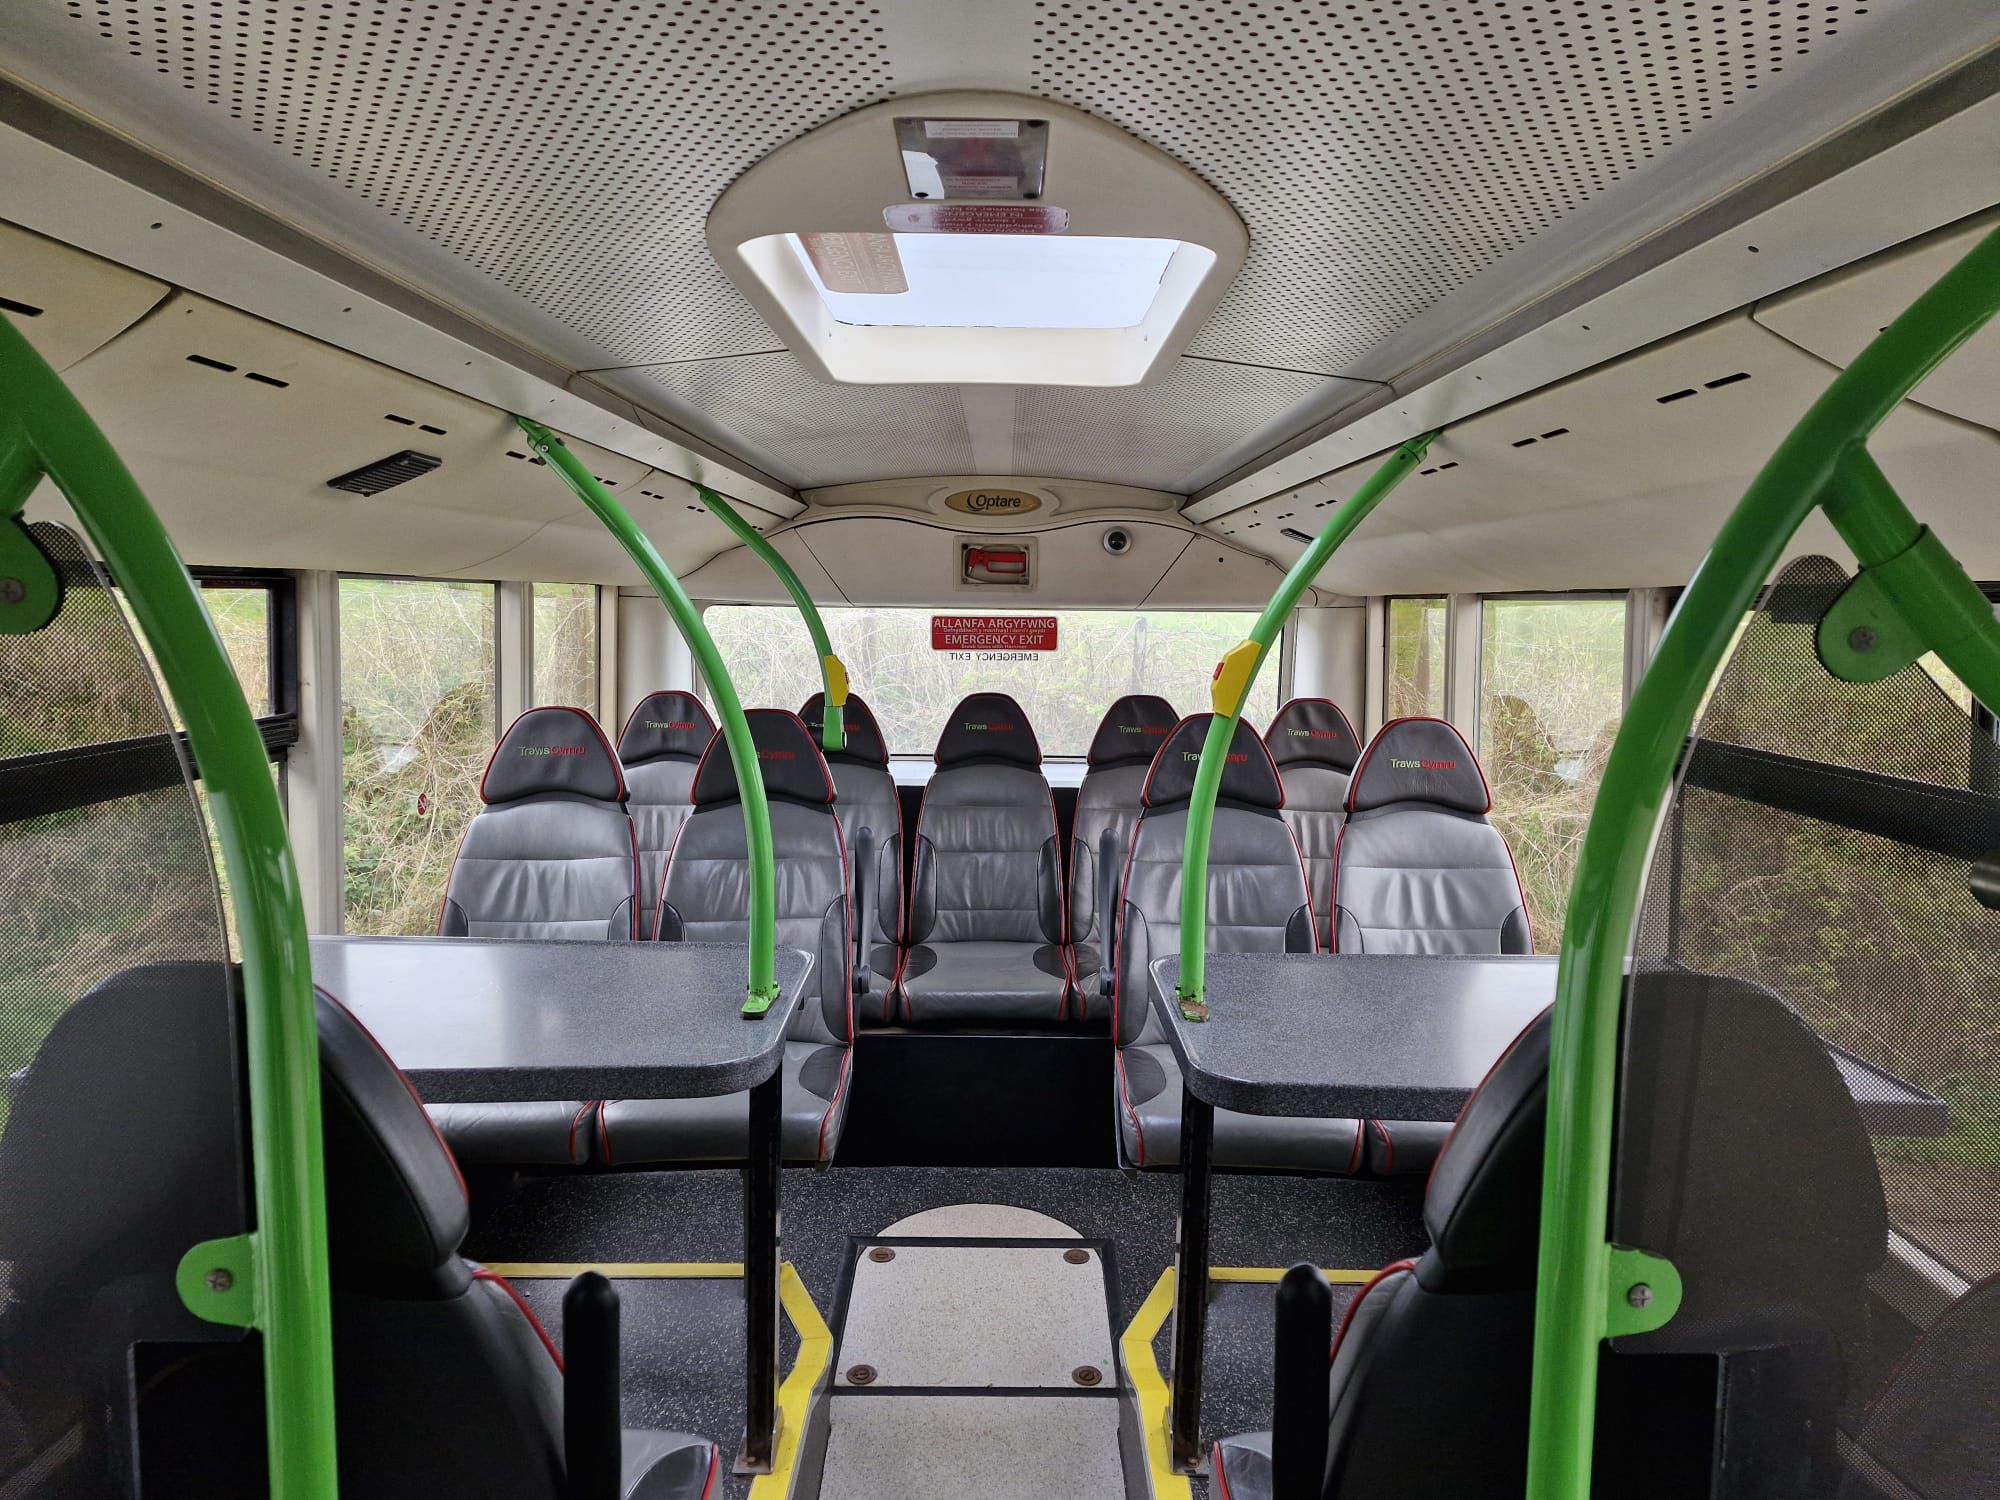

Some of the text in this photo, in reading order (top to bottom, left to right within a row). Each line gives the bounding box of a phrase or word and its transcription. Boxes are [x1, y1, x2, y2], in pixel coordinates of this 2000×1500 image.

[974, 494, 1022, 510] Optare
[934, 618, 1055, 628] ALLANFA ARGYFWNG
[945, 634, 1044, 645] EMERGENCY EXIT
